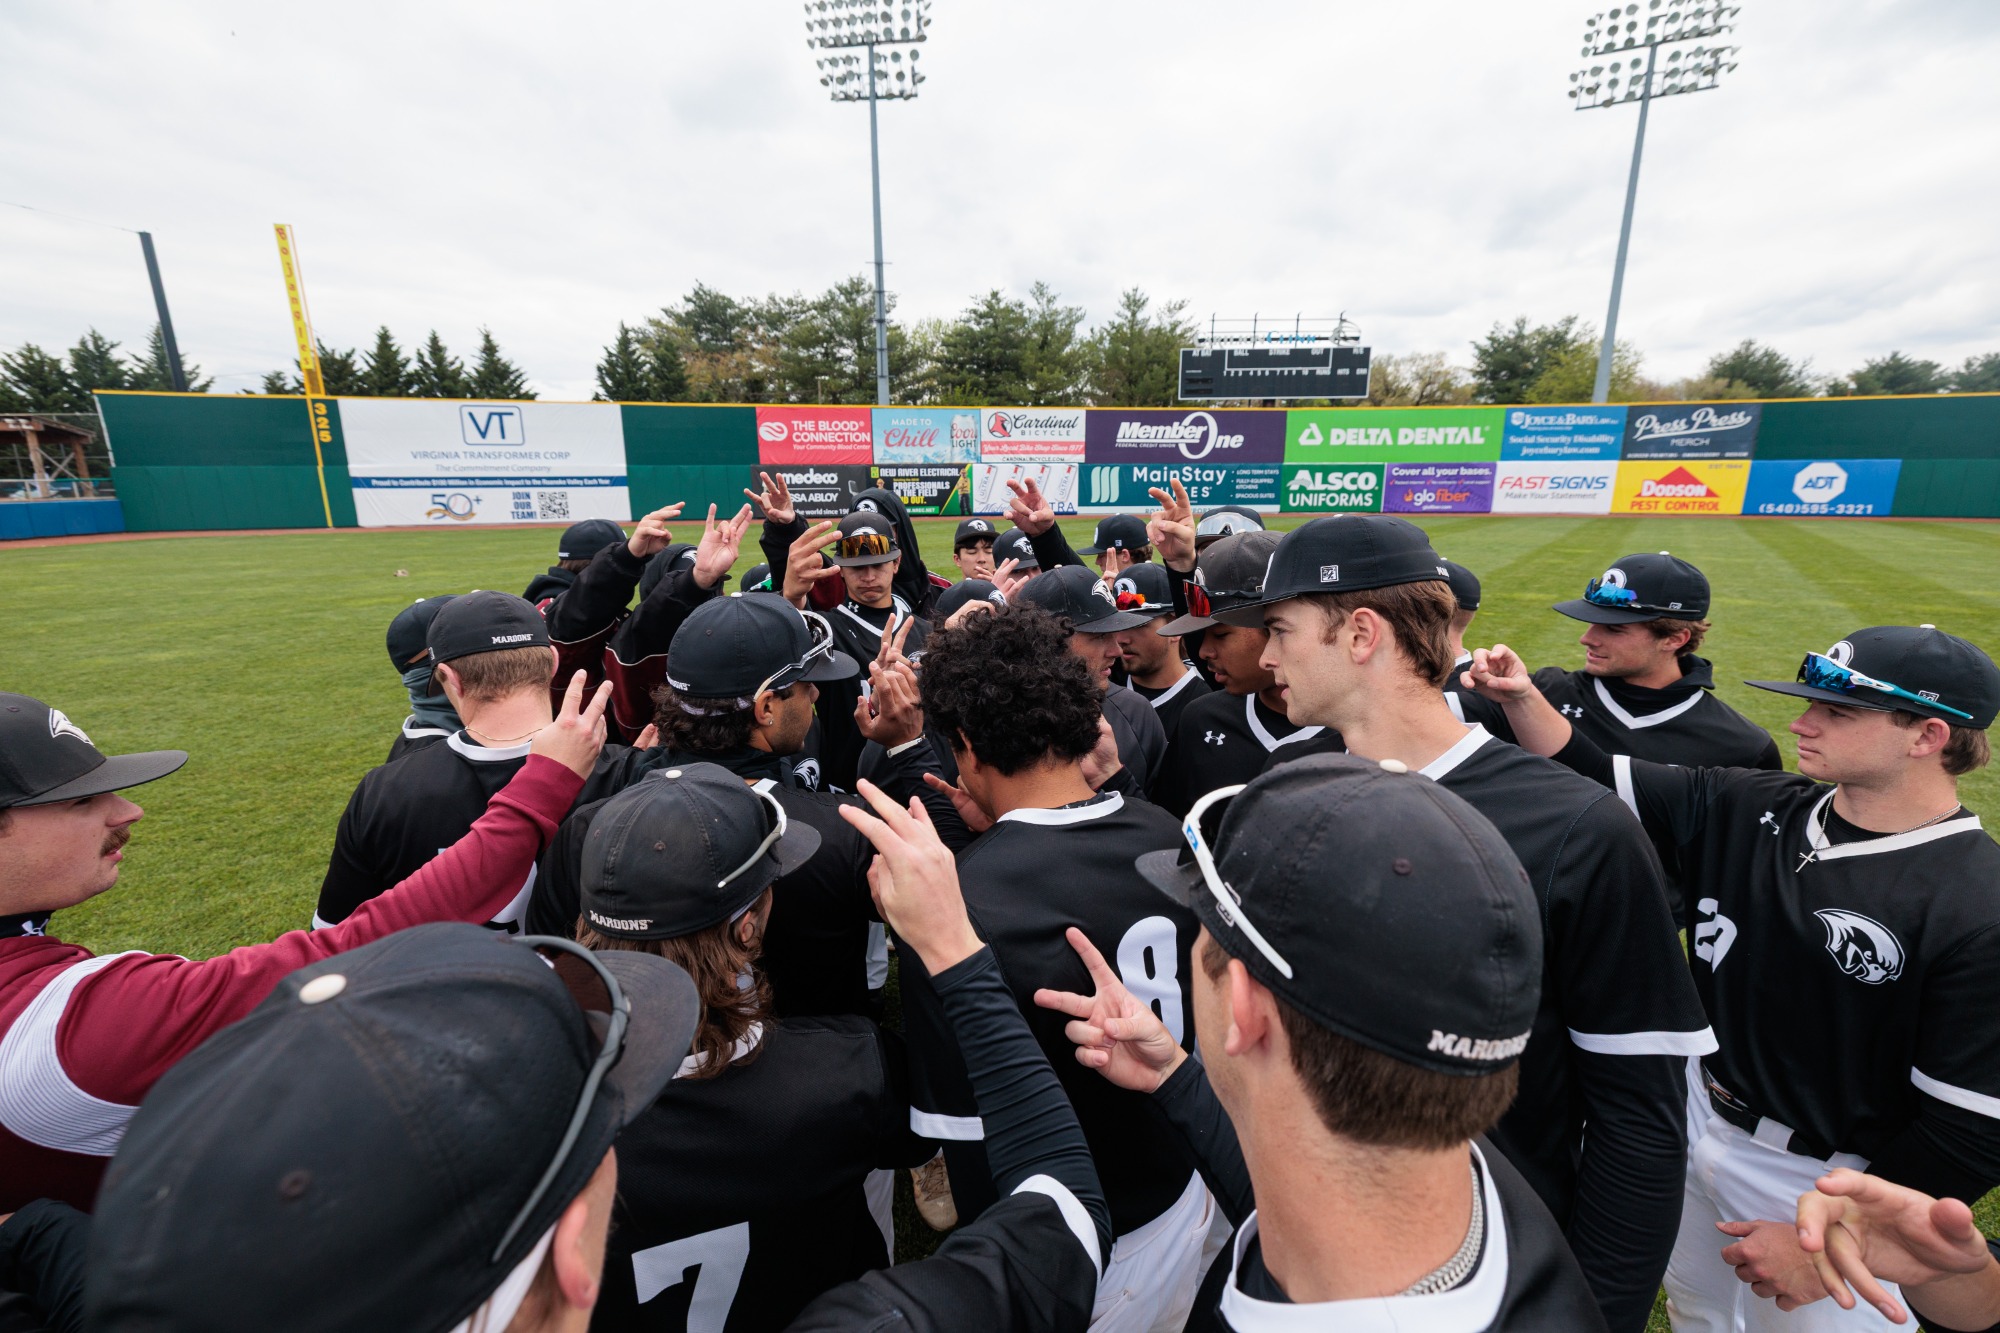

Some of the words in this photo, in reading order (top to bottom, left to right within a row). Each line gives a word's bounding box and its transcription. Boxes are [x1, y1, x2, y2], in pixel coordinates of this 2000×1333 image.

[1269, 348, 1290, 356] STRIKE
[1311, 347, 1324, 355] OUT
[314, 403, 332, 442] 325
[468, 412, 514, 439] VT
[792, 421, 815, 431] THE
[818, 421, 859, 431] BLOOD
[1013, 414, 1079, 429] Cardinal
[1632, 414, 1689, 439] Press
[1690, 407, 1748, 431] Press
[1117, 422, 1207, 439] Member
[1330, 428, 1393, 445] DELTA
[1398, 427, 1484, 445] DENTAL
[793, 432, 870, 442] CONNECTION
[884, 428, 939, 448] Chill
[1509, 434, 1535, 443] Social
[1536, 434, 1571, 444] Security
[1573, 434, 1615, 444] Disability
[1670, 438, 1710, 447] MERCH
[984, 444, 1000, 452] Your
[1001, 444, 1018, 452] Local
[1034, 444, 1050, 453] Shop
[411, 451, 460, 460] VIRGINIA
[464, 451, 541, 460] TRANSFORMER
[544, 451, 571, 460] CORP
[511, 465, 551, 473] Company
[880, 468, 896, 477] NEW
[898, 468, 918, 476] RIVER
[920, 468, 960, 476] ELECTRICAL
[1392, 467, 1421, 476] Cover
[1421, 466, 1435, 475] all
[1436, 467, 1459, 477] your
[1460, 466, 1492, 475] bases.
[782, 468, 838, 484] medeco
[1133, 466, 1226, 485] MainStay
[1287, 470, 1378, 490] ALSCO
[504, 479, 524, 487] Impact
[893, 482, 950, 490] PROFESSIONALS
[980, 476, 989, 497] ULTRA
[1059, 475, 1069, 496] ULTRA
[1499, 476, 1608, 489] FASTSIGNS
[1802, 476, 1839, 489] ADT
[904, 489, 916, 497] THE
[918, 489, 938, 497] FIELD
[1641, 480, 1707, 497] DODSON
[513, 491, 531, 500] JOIN
[790, 492, 807, 503] SSA
[808, 492, 839, 503] ABLOY
[911, 496, 927, 504] OUT.
[1289, 493, 1373, 507] UNIFORMS
[1551, 492, 1597, 500] Statement
[514, 501, 532, 510] OUR
[1630, 501, 1660, 510] PEST
[1665, 501, 1720, 511] CONTROL
[511, 511, 538, 520] TEAM!
[491, 634, 533, 644] MAROONS
[590, 910, 653, 930] MAROONS
[1117, 916, 1184, 1047] 8
[631, 1221, 750, 1333] 7
